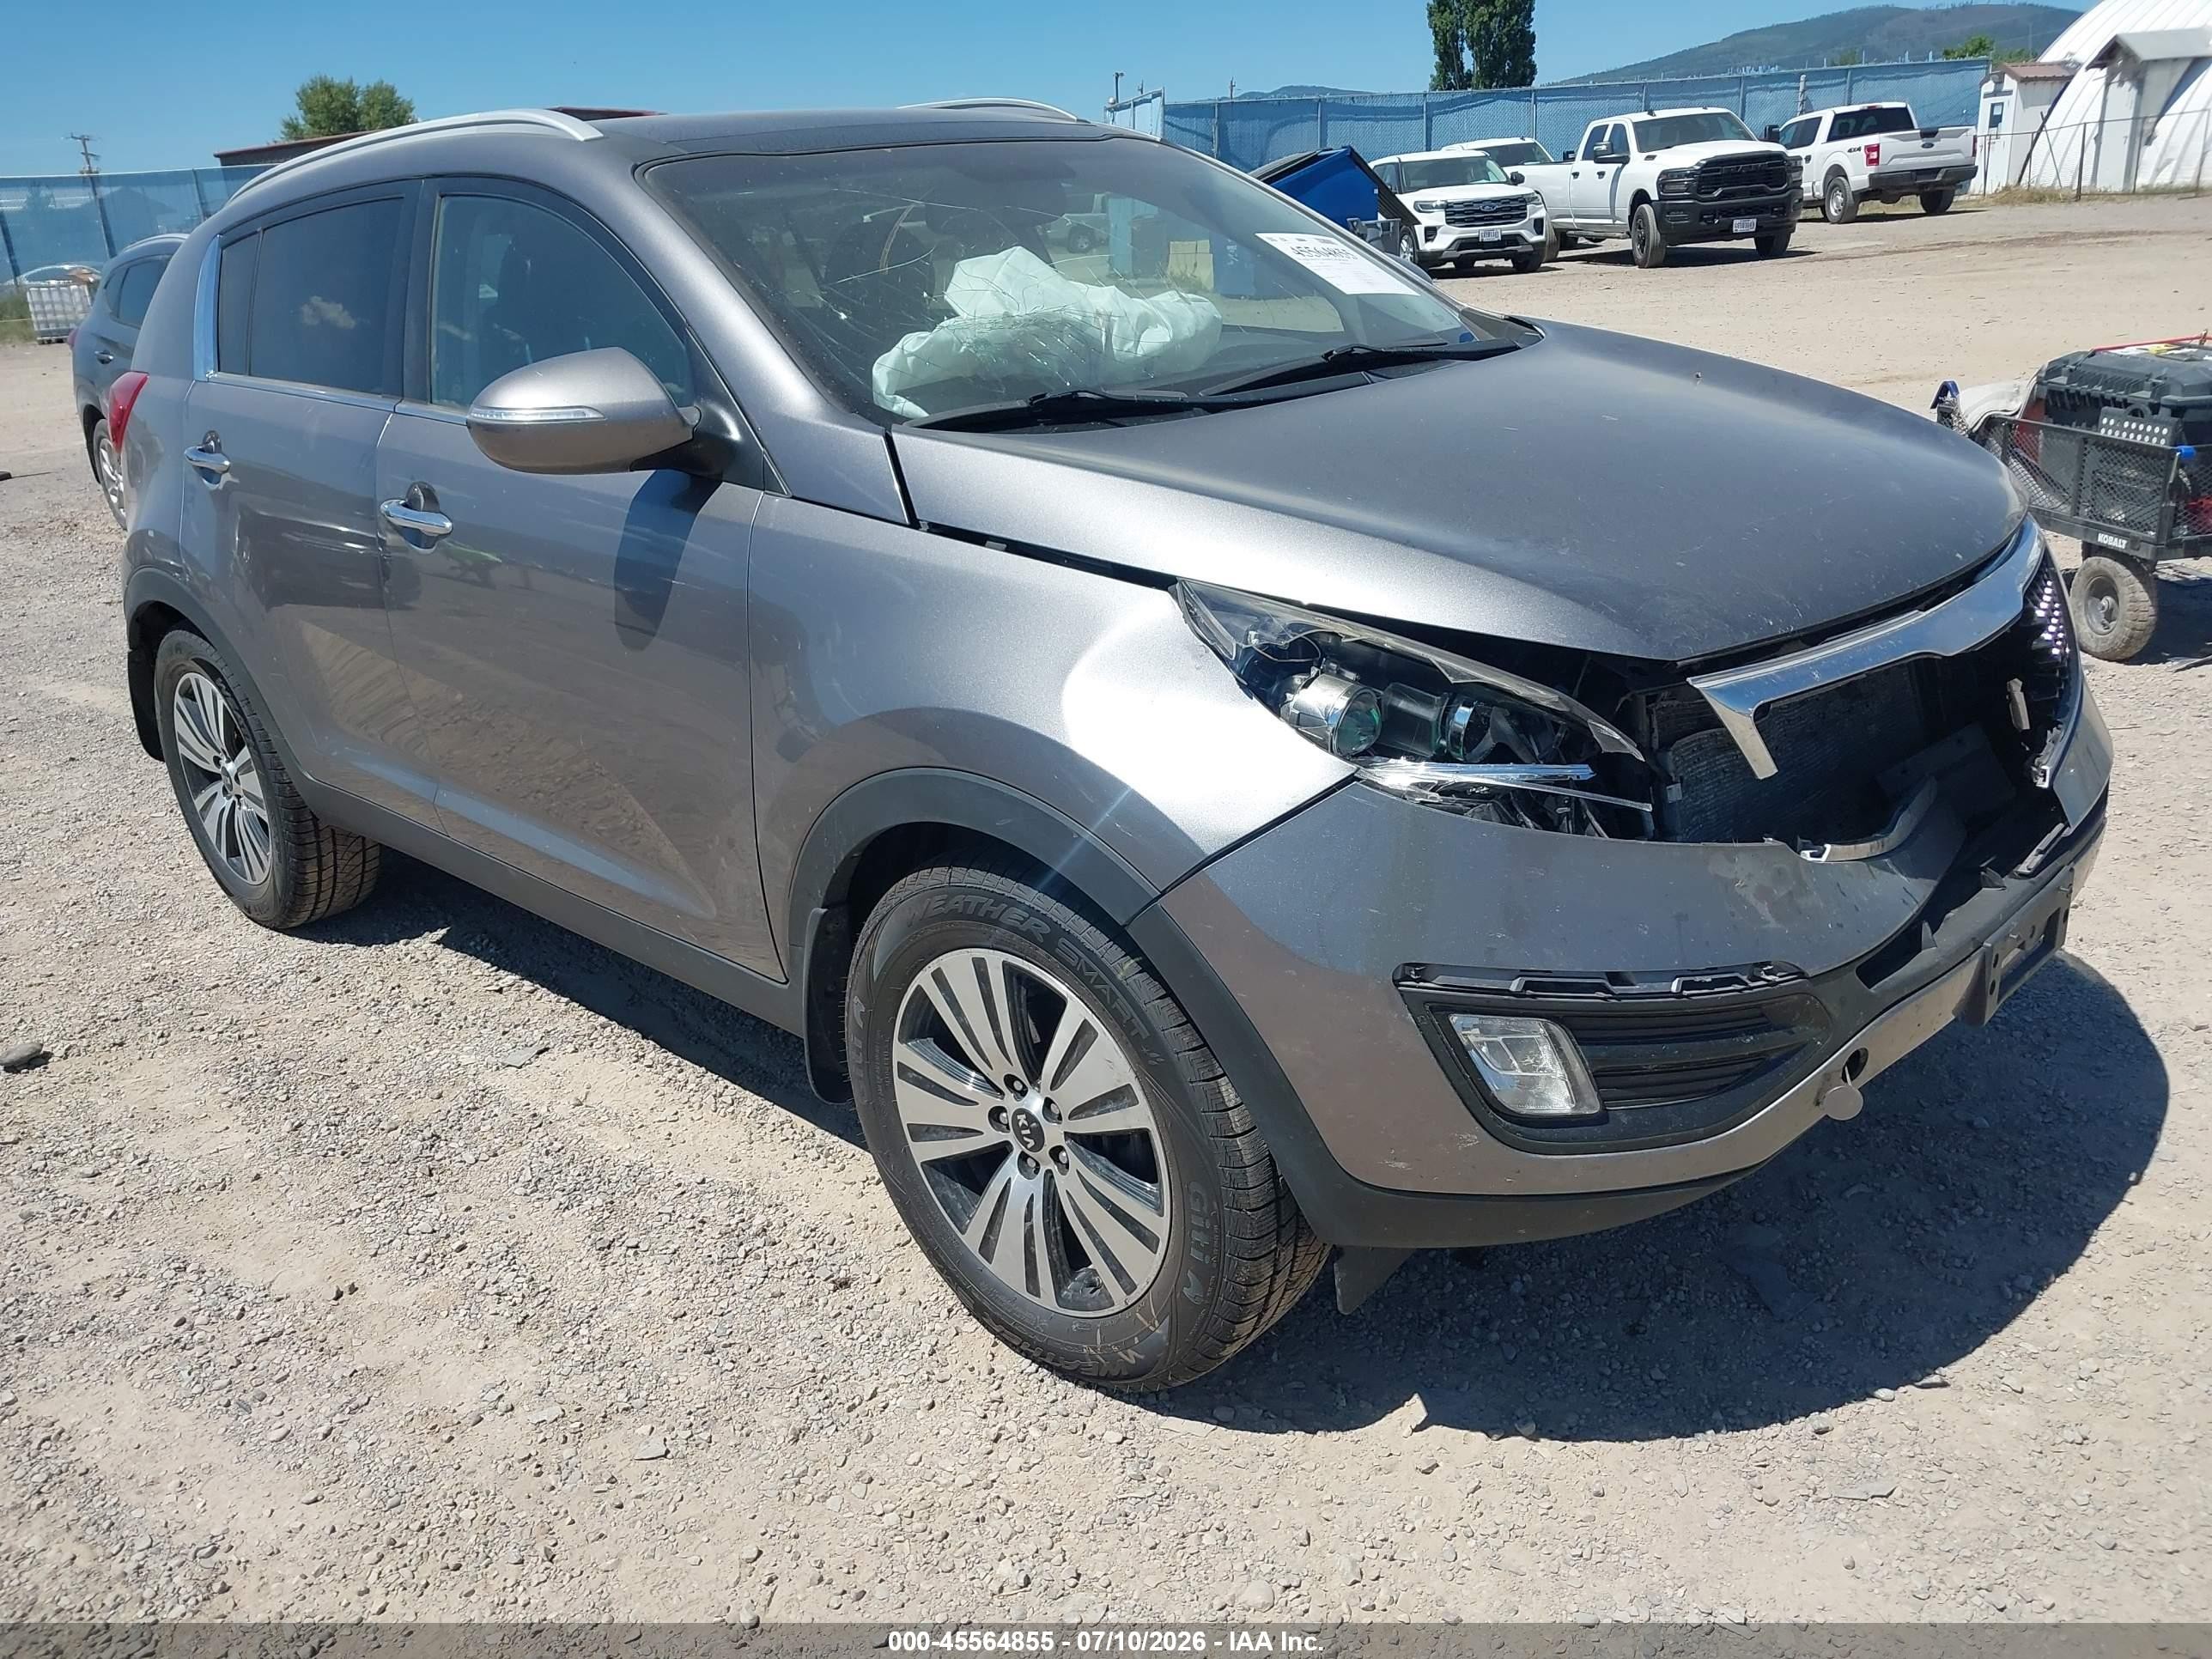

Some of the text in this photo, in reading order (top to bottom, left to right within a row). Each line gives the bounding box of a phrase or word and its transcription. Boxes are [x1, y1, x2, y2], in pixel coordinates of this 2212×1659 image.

[2098, 532, 2128, 550] KOBALT
[906, 893, 1151, 1040] WEATHER SMART
[1017, 1113, 1036, 1149] KIA
